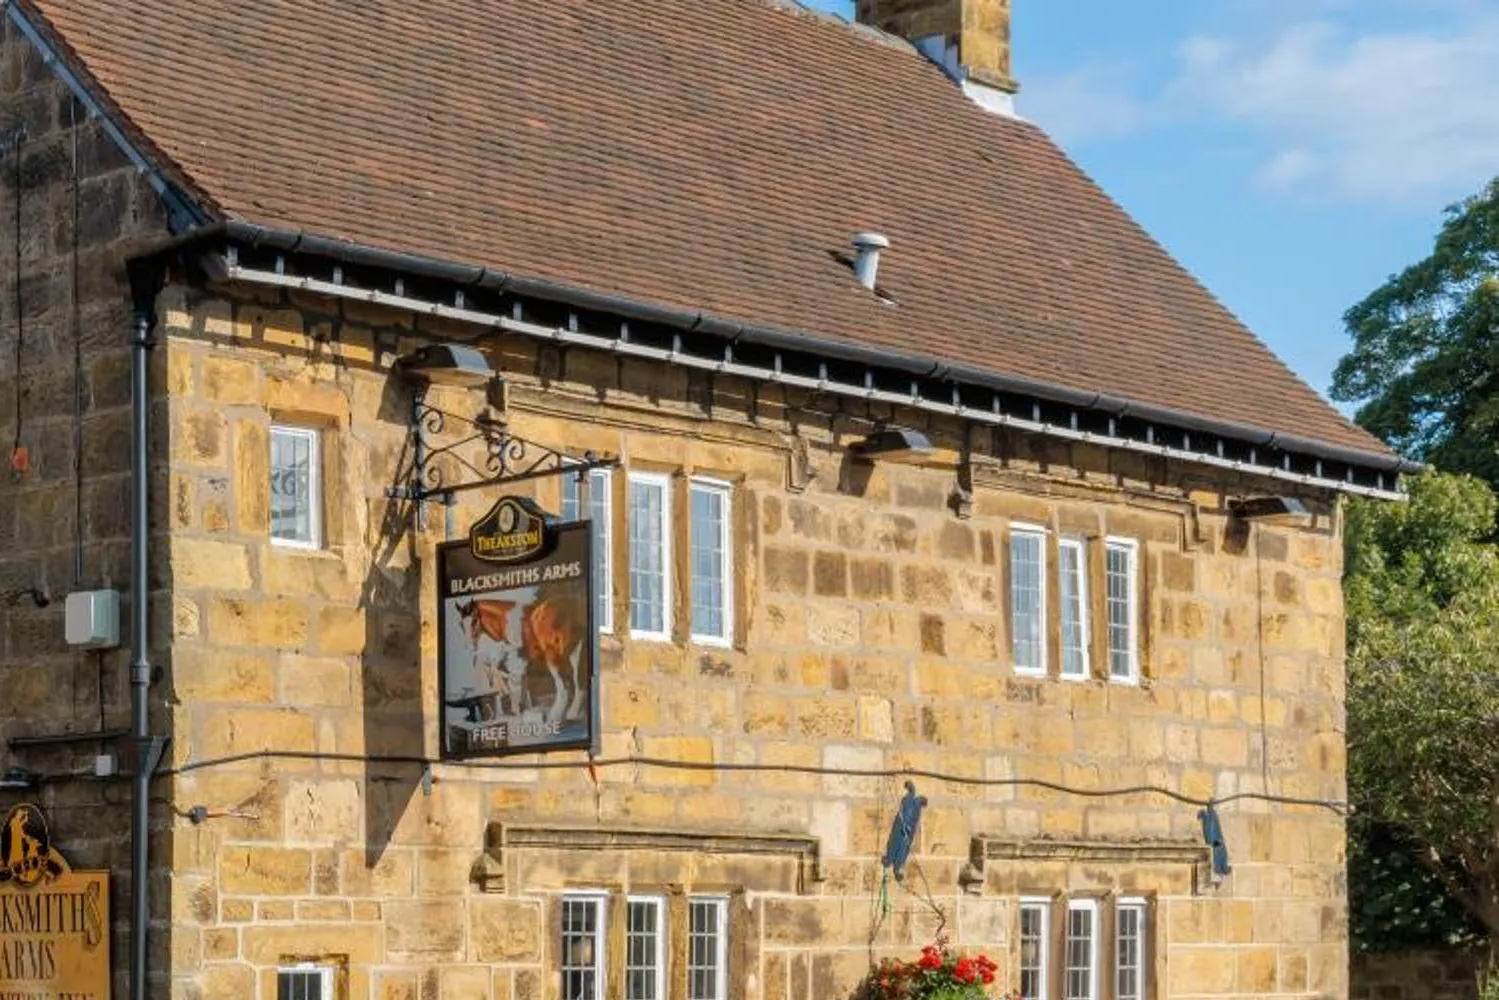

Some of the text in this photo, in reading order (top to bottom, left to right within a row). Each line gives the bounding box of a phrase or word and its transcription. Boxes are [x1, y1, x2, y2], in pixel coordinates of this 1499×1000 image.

[451, 561, 581, 593] BLACKSMITHS ARMS
[472, 719, 561, 742] FREE HOUSE
